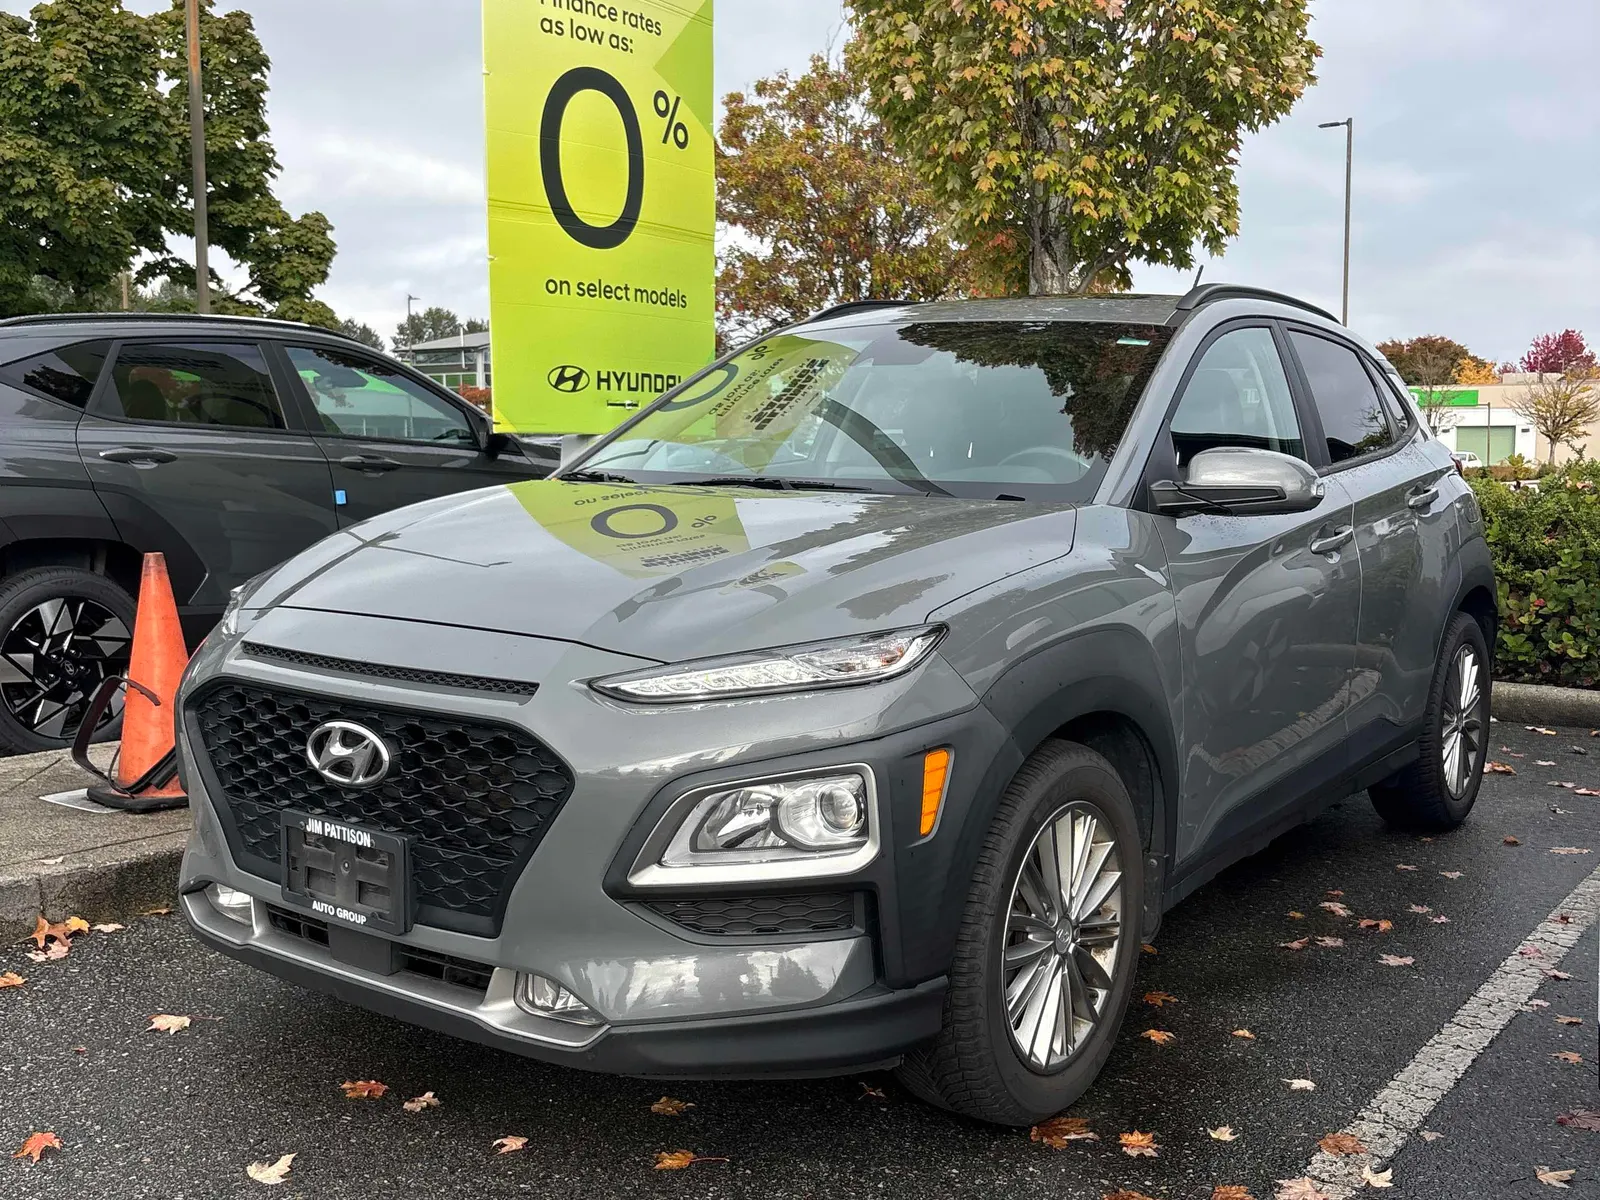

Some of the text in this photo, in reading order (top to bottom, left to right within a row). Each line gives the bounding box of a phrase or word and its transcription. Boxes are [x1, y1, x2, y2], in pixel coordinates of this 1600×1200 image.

[540, 0, 662, 36] nance rates
[540, 17, 634, 54] as low as:
[545, 278, 687, 309] on select models
[306, 818, 371, 848] JIM PATTISON
[312, 900, 367, 925] AUTO GROUP
